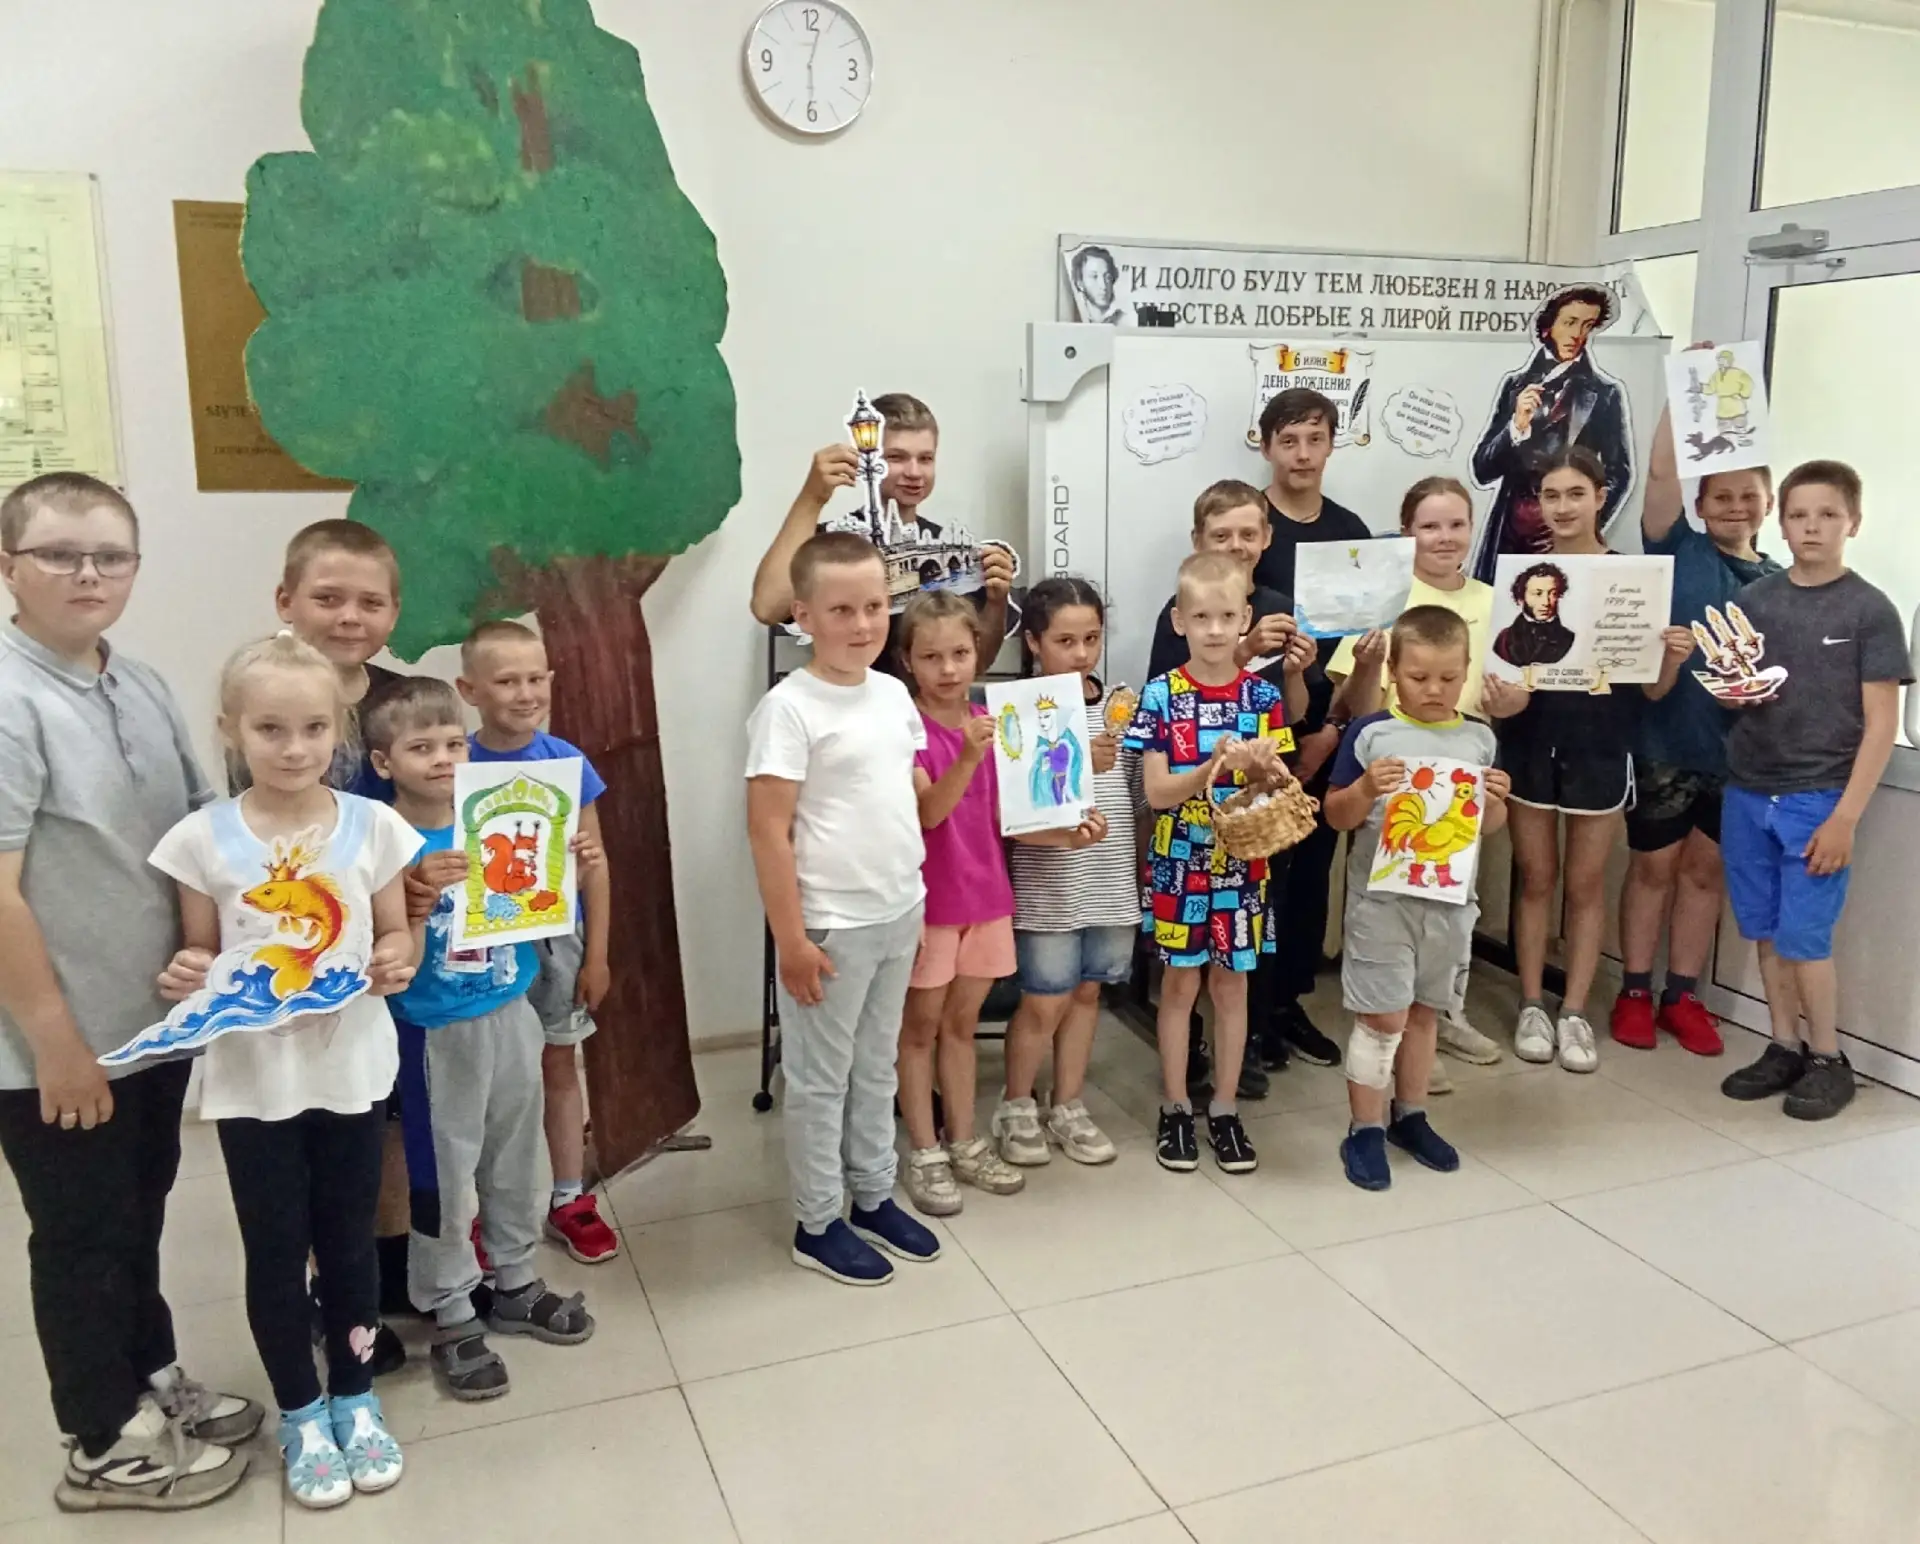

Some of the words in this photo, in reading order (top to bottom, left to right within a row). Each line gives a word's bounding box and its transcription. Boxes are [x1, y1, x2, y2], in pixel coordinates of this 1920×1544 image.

[802, 9, 820, 32] 12
[761, 48, 773, 72] 9
[847, 58, 858, 82] 3
[806, 100, 818, 123] 6
[1155, 266, 1236, 291] ДОЛГО
[1243, 269, 1308, 294] БУДУ
[1315, 271, 1363, 294] ТЕМ
[1369, 273, 1479, 299] ЛЮБЕЗЕН
[1483, 278, 1497, 299] Я
[1504, 279, 1566, 300] НАРО
[1254, 303, 1352, 328] ДОБРЫЕ
[1360, 306, 1375, 329] Я
[1380, 305, 1451, 331] ЛИРОЙ
[1458, 310, 1533, 332] ПРОБУ
[1293, 352, 1301, 367] 6
[1262, 374, 1290, 389] ДЕНЬ
[1294, 375, 1352, 391] РОЖДЕНИЯ
